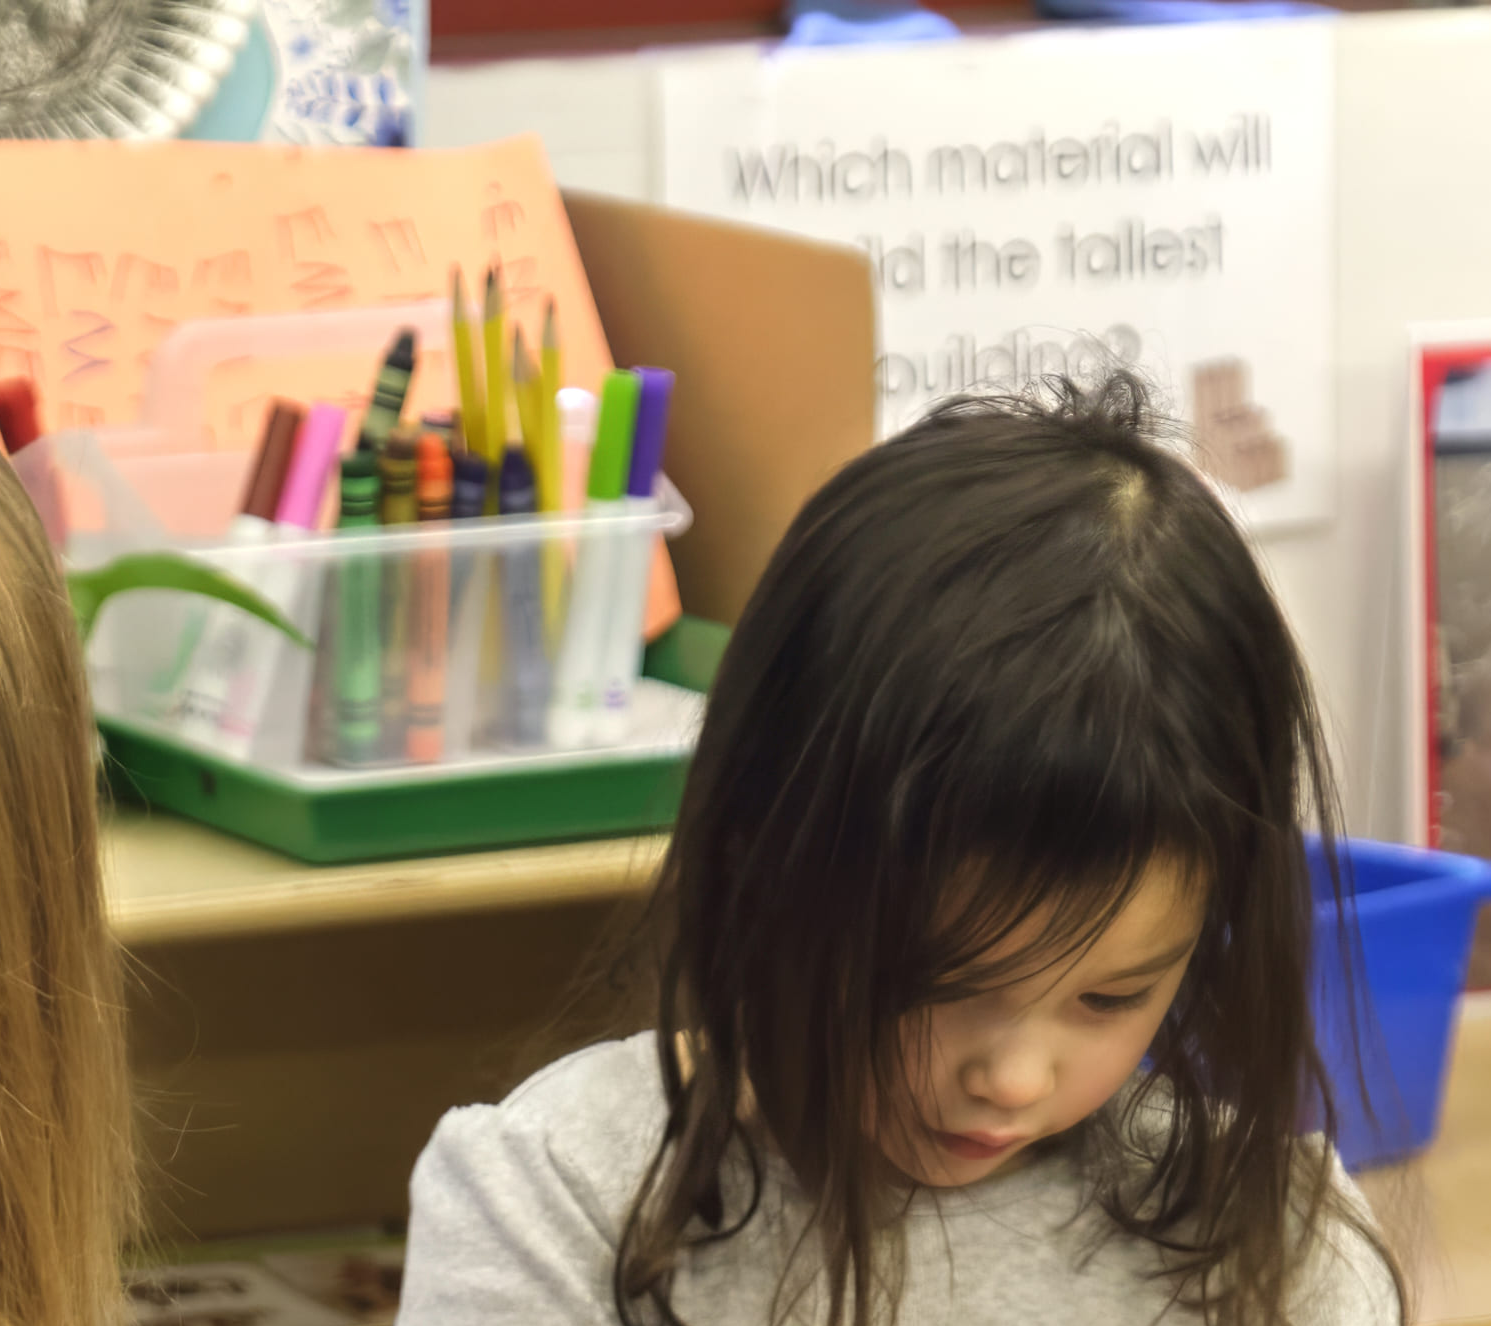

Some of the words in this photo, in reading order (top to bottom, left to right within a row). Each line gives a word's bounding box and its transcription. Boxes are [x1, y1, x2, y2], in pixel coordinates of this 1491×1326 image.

[727, 137, 914, 202] Which
[926, 118, 1174, 195] material
[1191, 112, 1272, 176] will
[942, 224, 1043, 292] the
[1054, 210, 1226, 282] tallest
